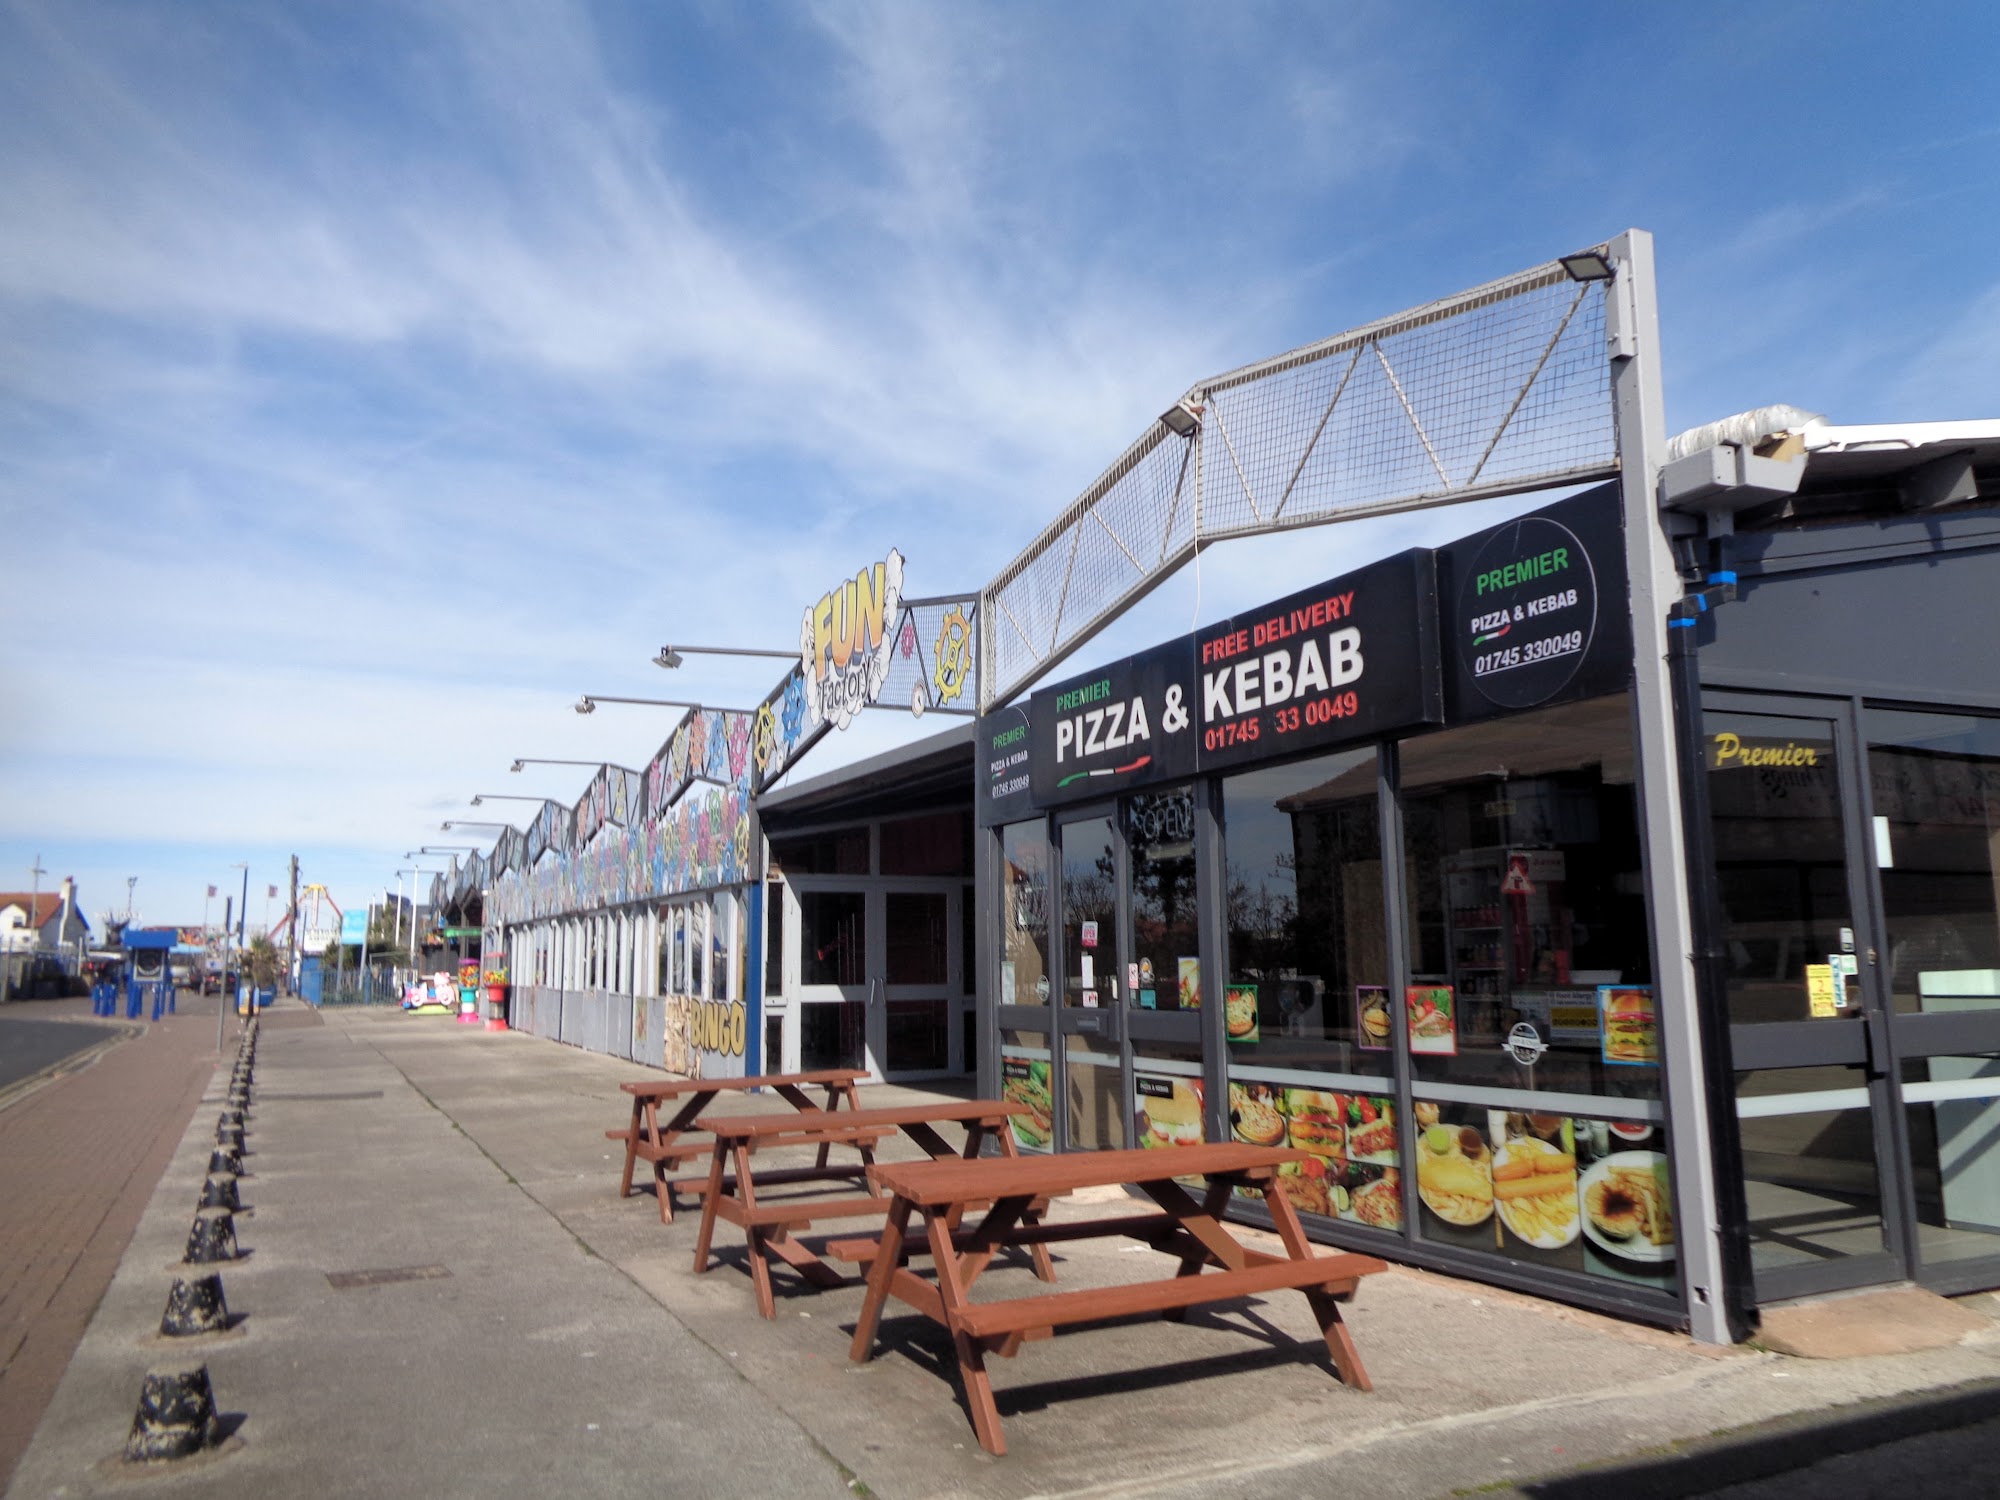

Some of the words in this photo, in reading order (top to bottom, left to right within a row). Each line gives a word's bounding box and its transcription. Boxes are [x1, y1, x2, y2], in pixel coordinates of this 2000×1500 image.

[1477, 547, 1569, 596] PREMIER
[812, 562, 885, 683] FUN
[1202, 628, 1249, 665] FREE
[1253, 590, 1355, 648] DELIVERY
[1471, 609, 1510, 633] PIZZA
[1513, 604, 1525, 622] &
[1527, 589, 1578, 618] KEBAB
[1474, 647, 1520, 674] 01745
[1522, 630, 1583, 662] 330049
[820, 655, 872, 716] Factory
[1056, 695, 1151, 763] PIZZA
[1162, 683, 1189, 734] &
[1203, 625, 1365, 723] KEBAB
[1056, 679, 1111, 713] PREMIER
[992, 725, 1026, 750] PREMIER
[1204, 717, 1261, 751] 01745
[1275, 706, 1300, 733] 33
[1305, 690, 1358, 726] 0049
[990, 758, 1006, 773] PIZZA
[1713, 732, 1818, 767] Premier
[1143, 804, 1189, 839] OPEN
[691, 997, 746, 1058] BINGO
